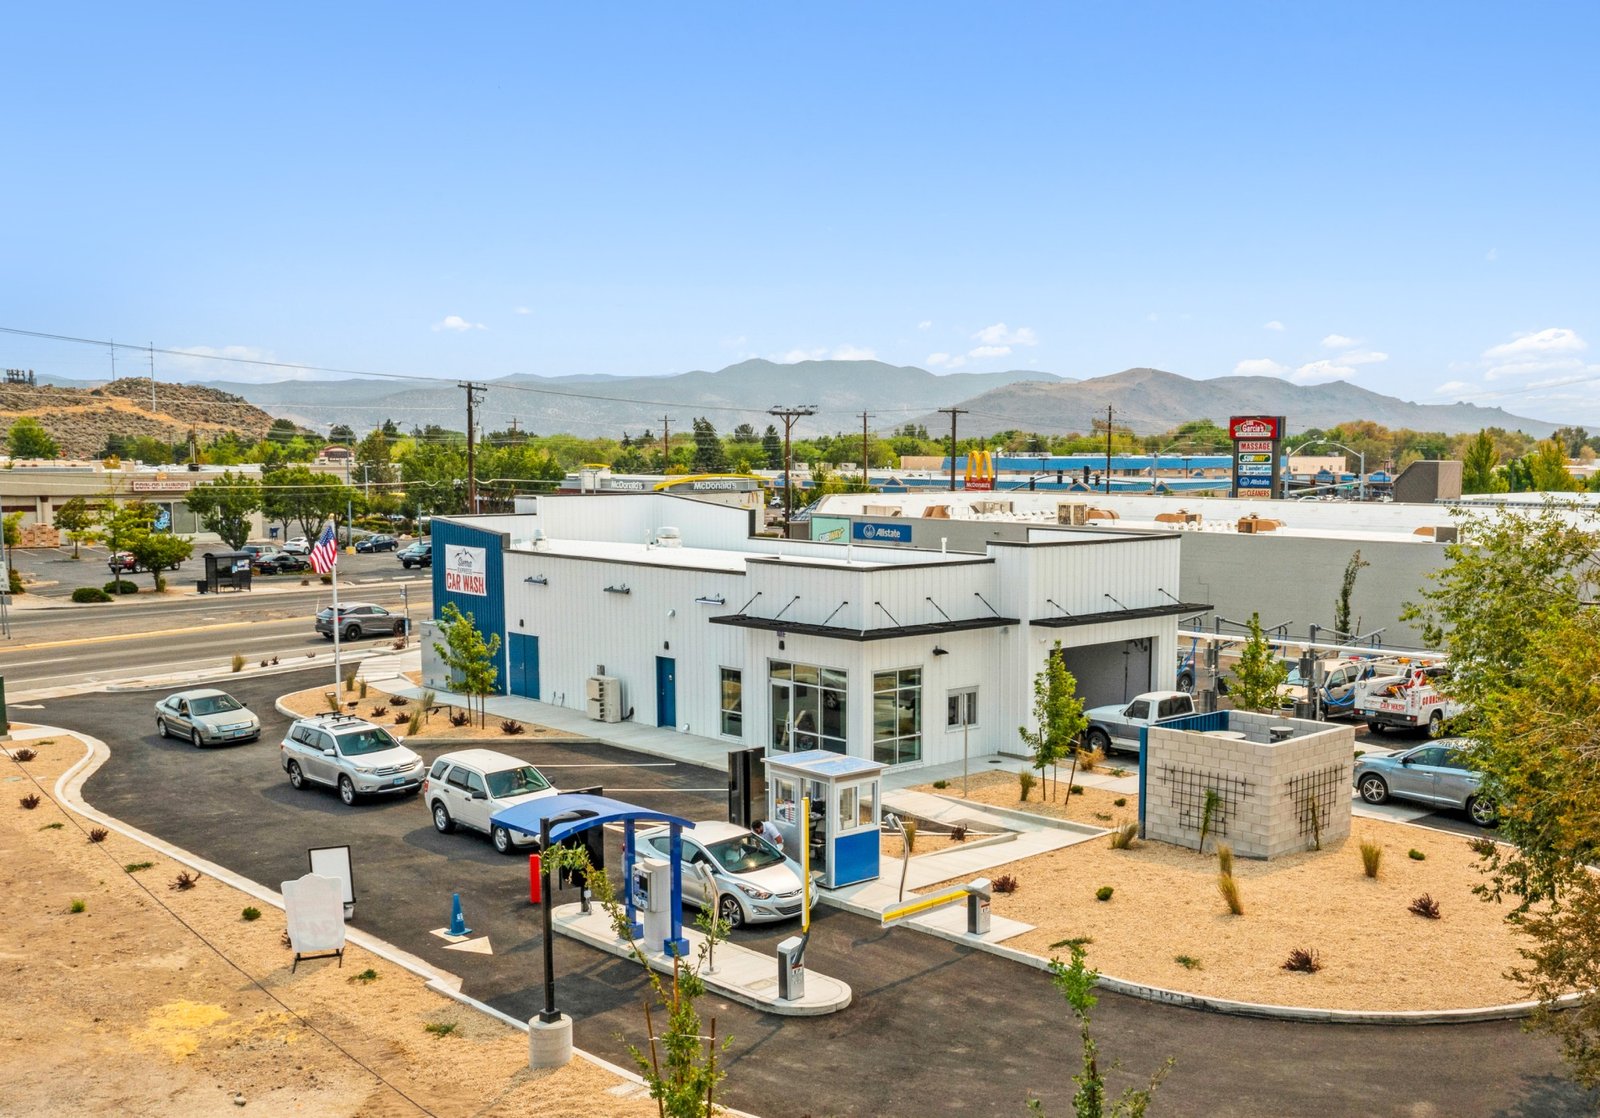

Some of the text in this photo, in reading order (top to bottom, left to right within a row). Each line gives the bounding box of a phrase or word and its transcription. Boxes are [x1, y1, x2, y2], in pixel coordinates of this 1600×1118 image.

[1240, 442, 1270, 450] MASSAGE
[161, 482, 189, 490] LAUNDRY
[610, 480, 643, 490] McDonald's
[693, 481, 737, 490] McDonald's
[875, 528, 901, 538] Allstate
[446, 572, 485, 594] CAR WASH
[1391, 704, 1405, 712] WASH
